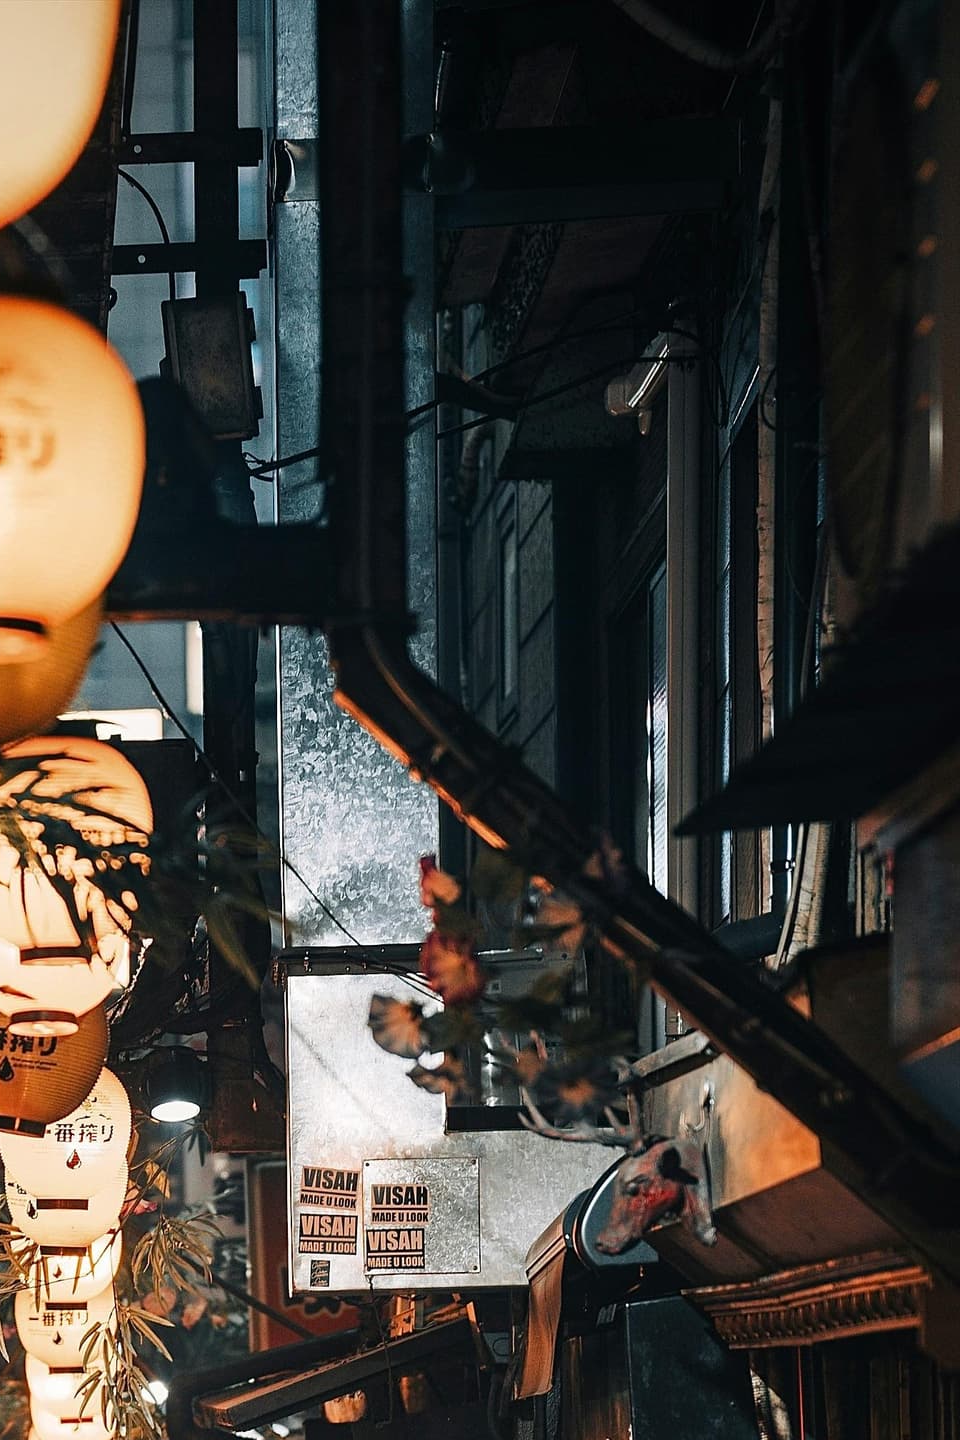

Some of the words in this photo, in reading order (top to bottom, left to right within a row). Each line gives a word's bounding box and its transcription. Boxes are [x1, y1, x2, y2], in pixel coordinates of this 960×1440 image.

[303, 1169, 359, 1192] VISAH
[300, 1193, 324, 1205] MADE
[326, 1196, 333, 1206] U
[334, 1197, 357, 1209] LOOK
[373, 1186, 428, 1206] VISAH
[372, 1212, 397, 1222] MADE
[398, 1212, 404, 1222] U
[406, 1211, 429, 1223] LOOK
[301, 1215, 356, 1237] VISAH
[300, 1242, 324, 1253] MADE
[326, 1242, 333, 1253] U
[333, 1243, 356, 1254] LOOK
[367, 1231, 423, 1250] VISAH
[367, 1257, 392, 1268] MADE
[394, 1257, 400, 1267] U
[401, 1256, 424, 1267] LOOK
